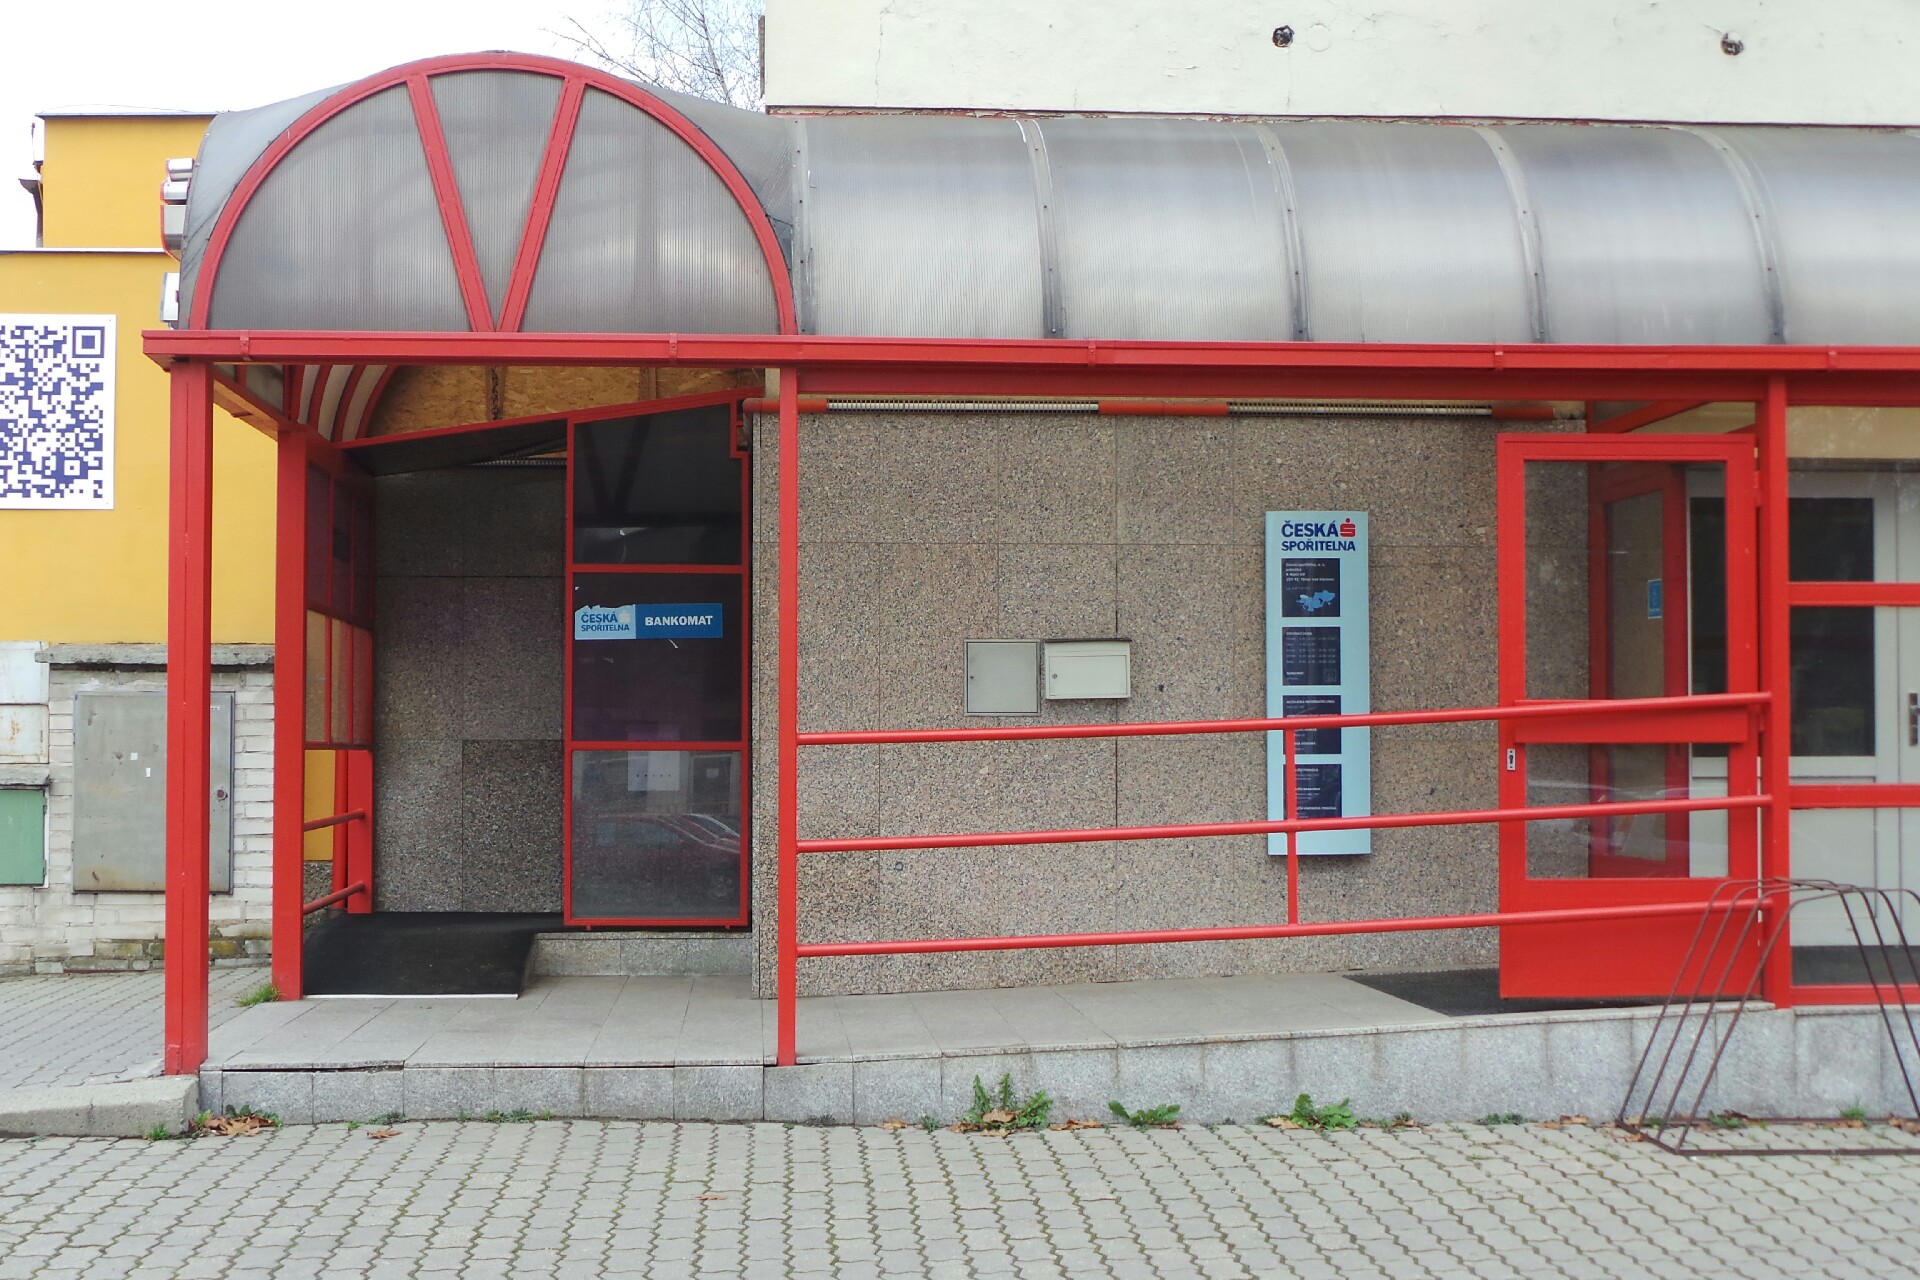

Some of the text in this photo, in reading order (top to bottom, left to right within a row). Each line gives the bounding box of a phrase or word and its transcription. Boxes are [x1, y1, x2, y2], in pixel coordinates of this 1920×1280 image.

[1281, 520, 1339, 537] ČESKÁ
[1281, 538, 1356, 551] SPOŘITELNA
[581, 611, 618, 623] ČESKÁ
[644, 615, 714, 626] BANKOMAT
[581, 622, 630, 632] SPOŘITELNA
